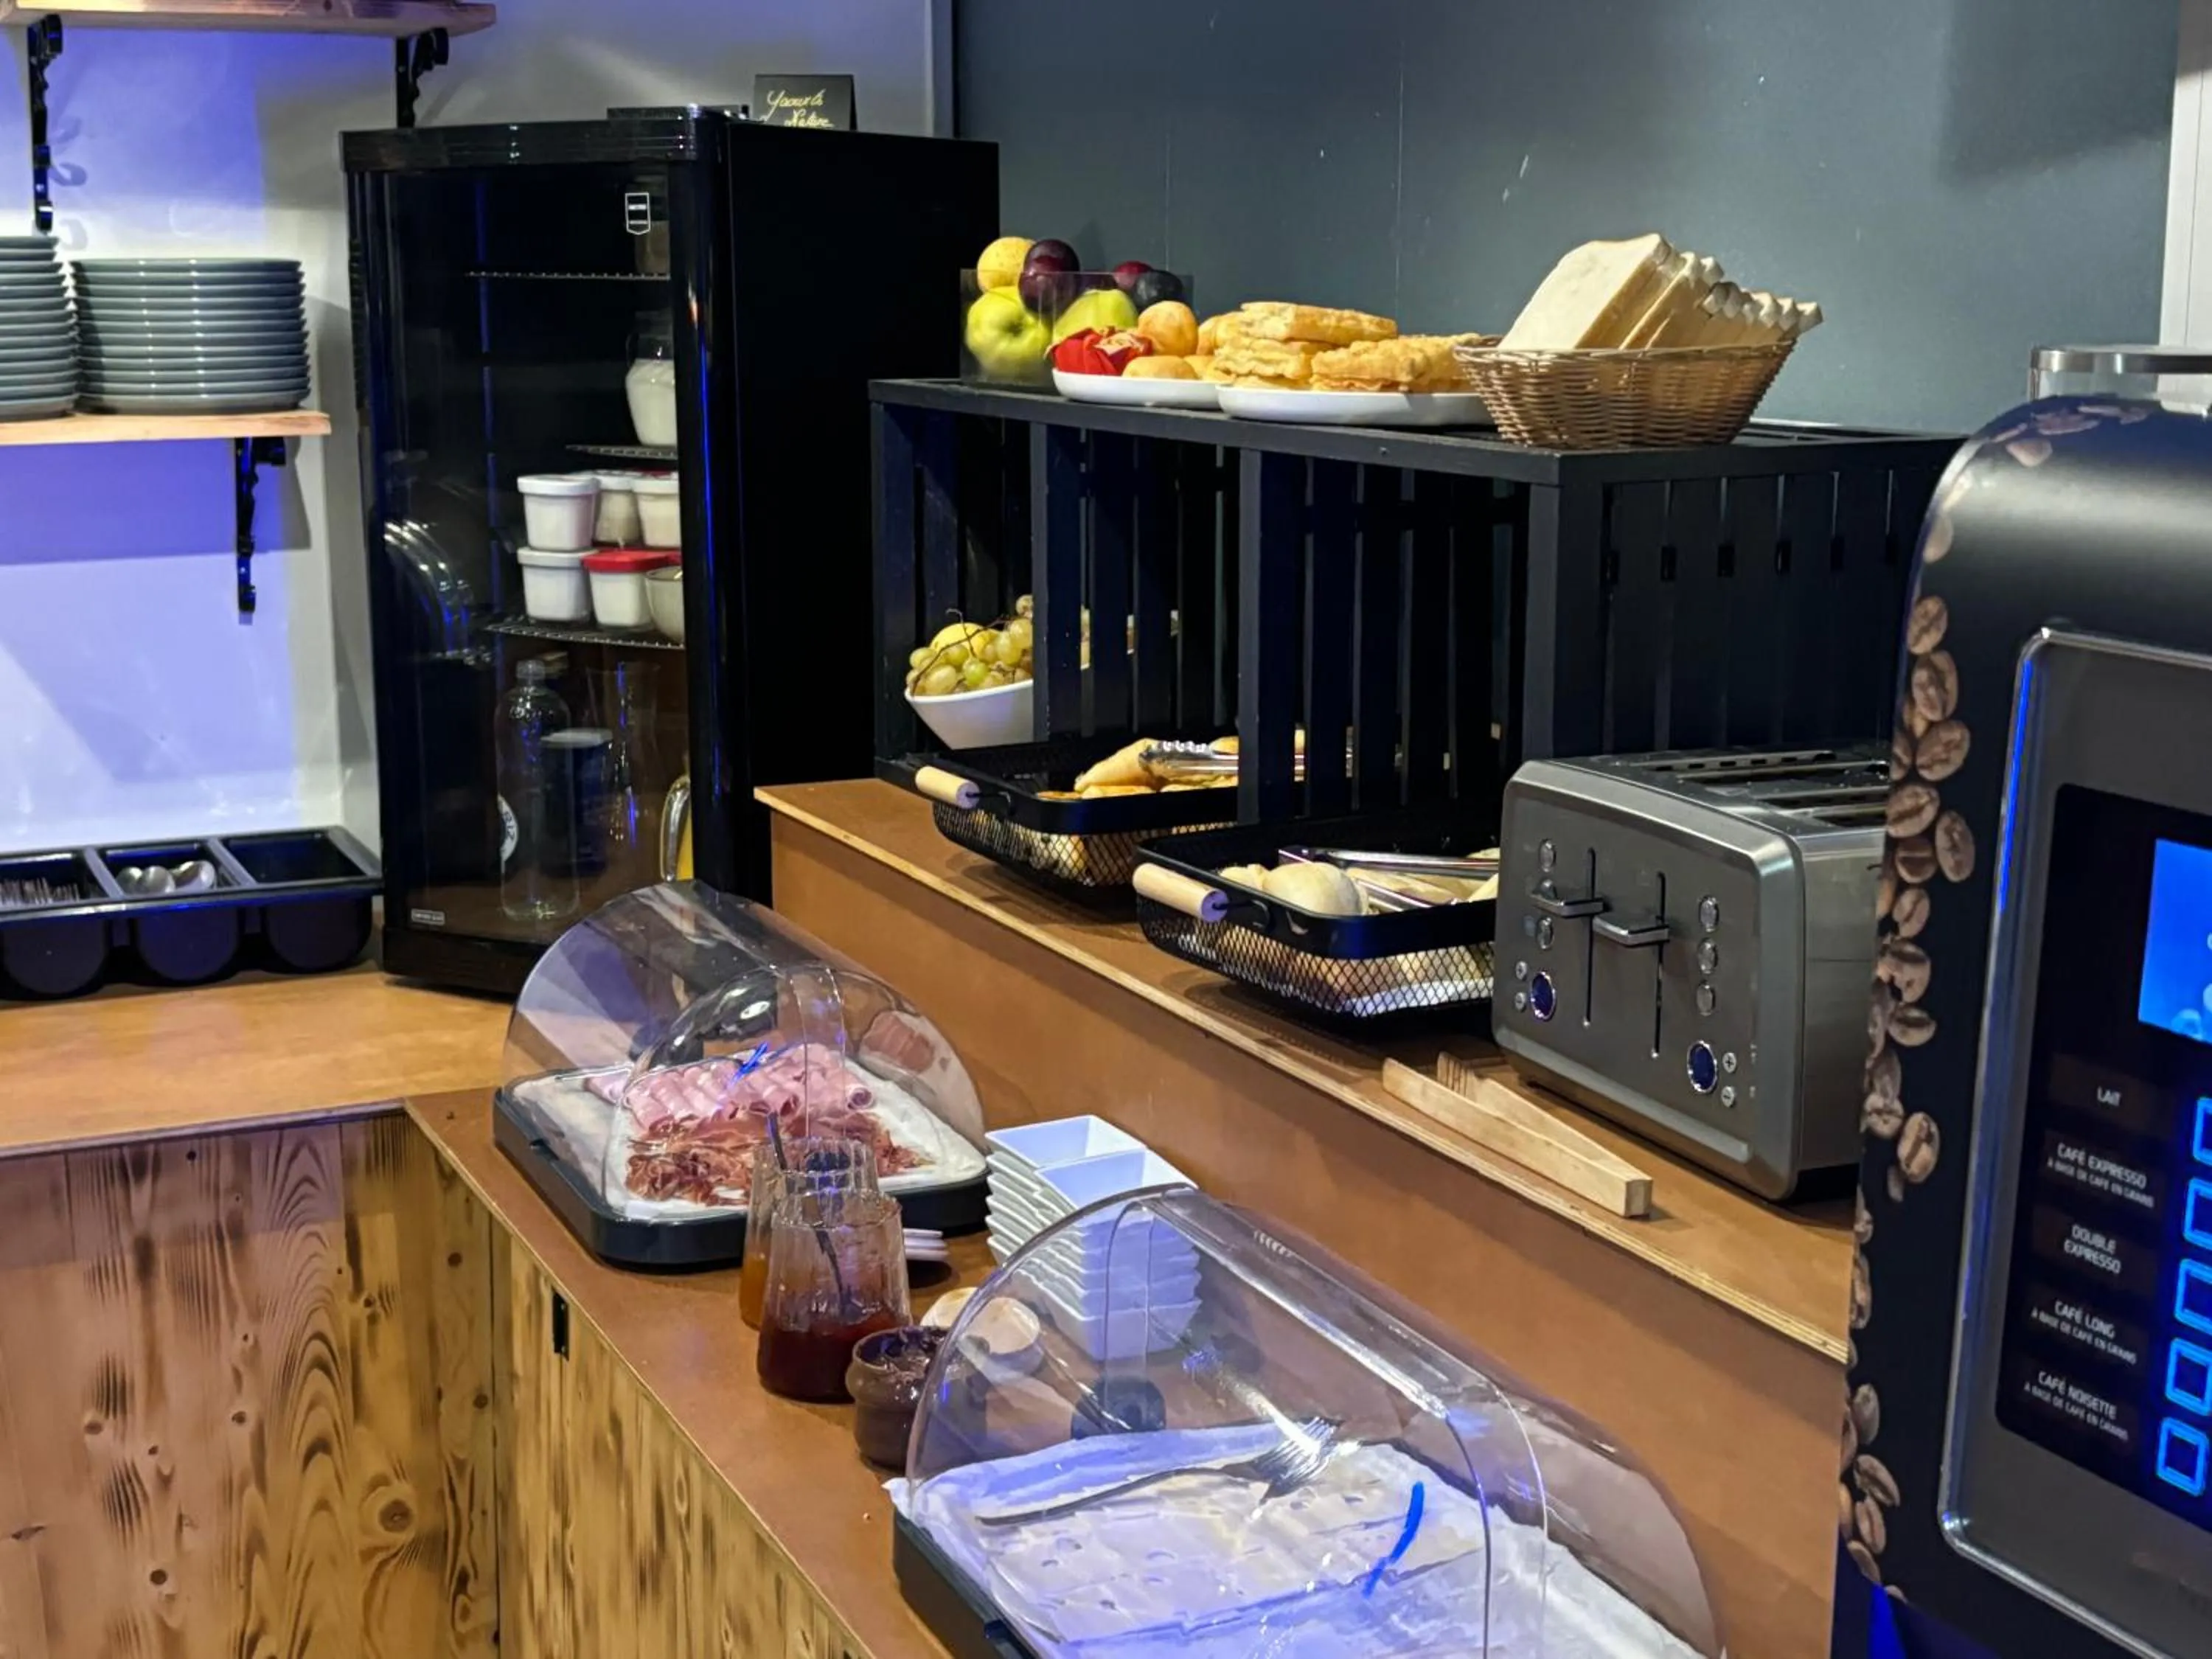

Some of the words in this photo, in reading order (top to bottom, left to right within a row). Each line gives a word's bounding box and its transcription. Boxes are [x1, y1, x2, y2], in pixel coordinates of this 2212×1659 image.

[2097, 1086, 2121, 1106] LAIT
[2088, 1155, 2147, 1189] EXPRESSO
[2072, 1224, 2116, 1254] DOUBLE
[2064, 1239, 2121, 1274] EXPRESSO
[2055, 1300, 2083, 1324] CAFÉ
[2084, 1314, 2115, 1339] LONG
[2038, 1370, 2066, 1394] CAFÉ
[2067, 1385, 2117, 1419] NOISETTE
